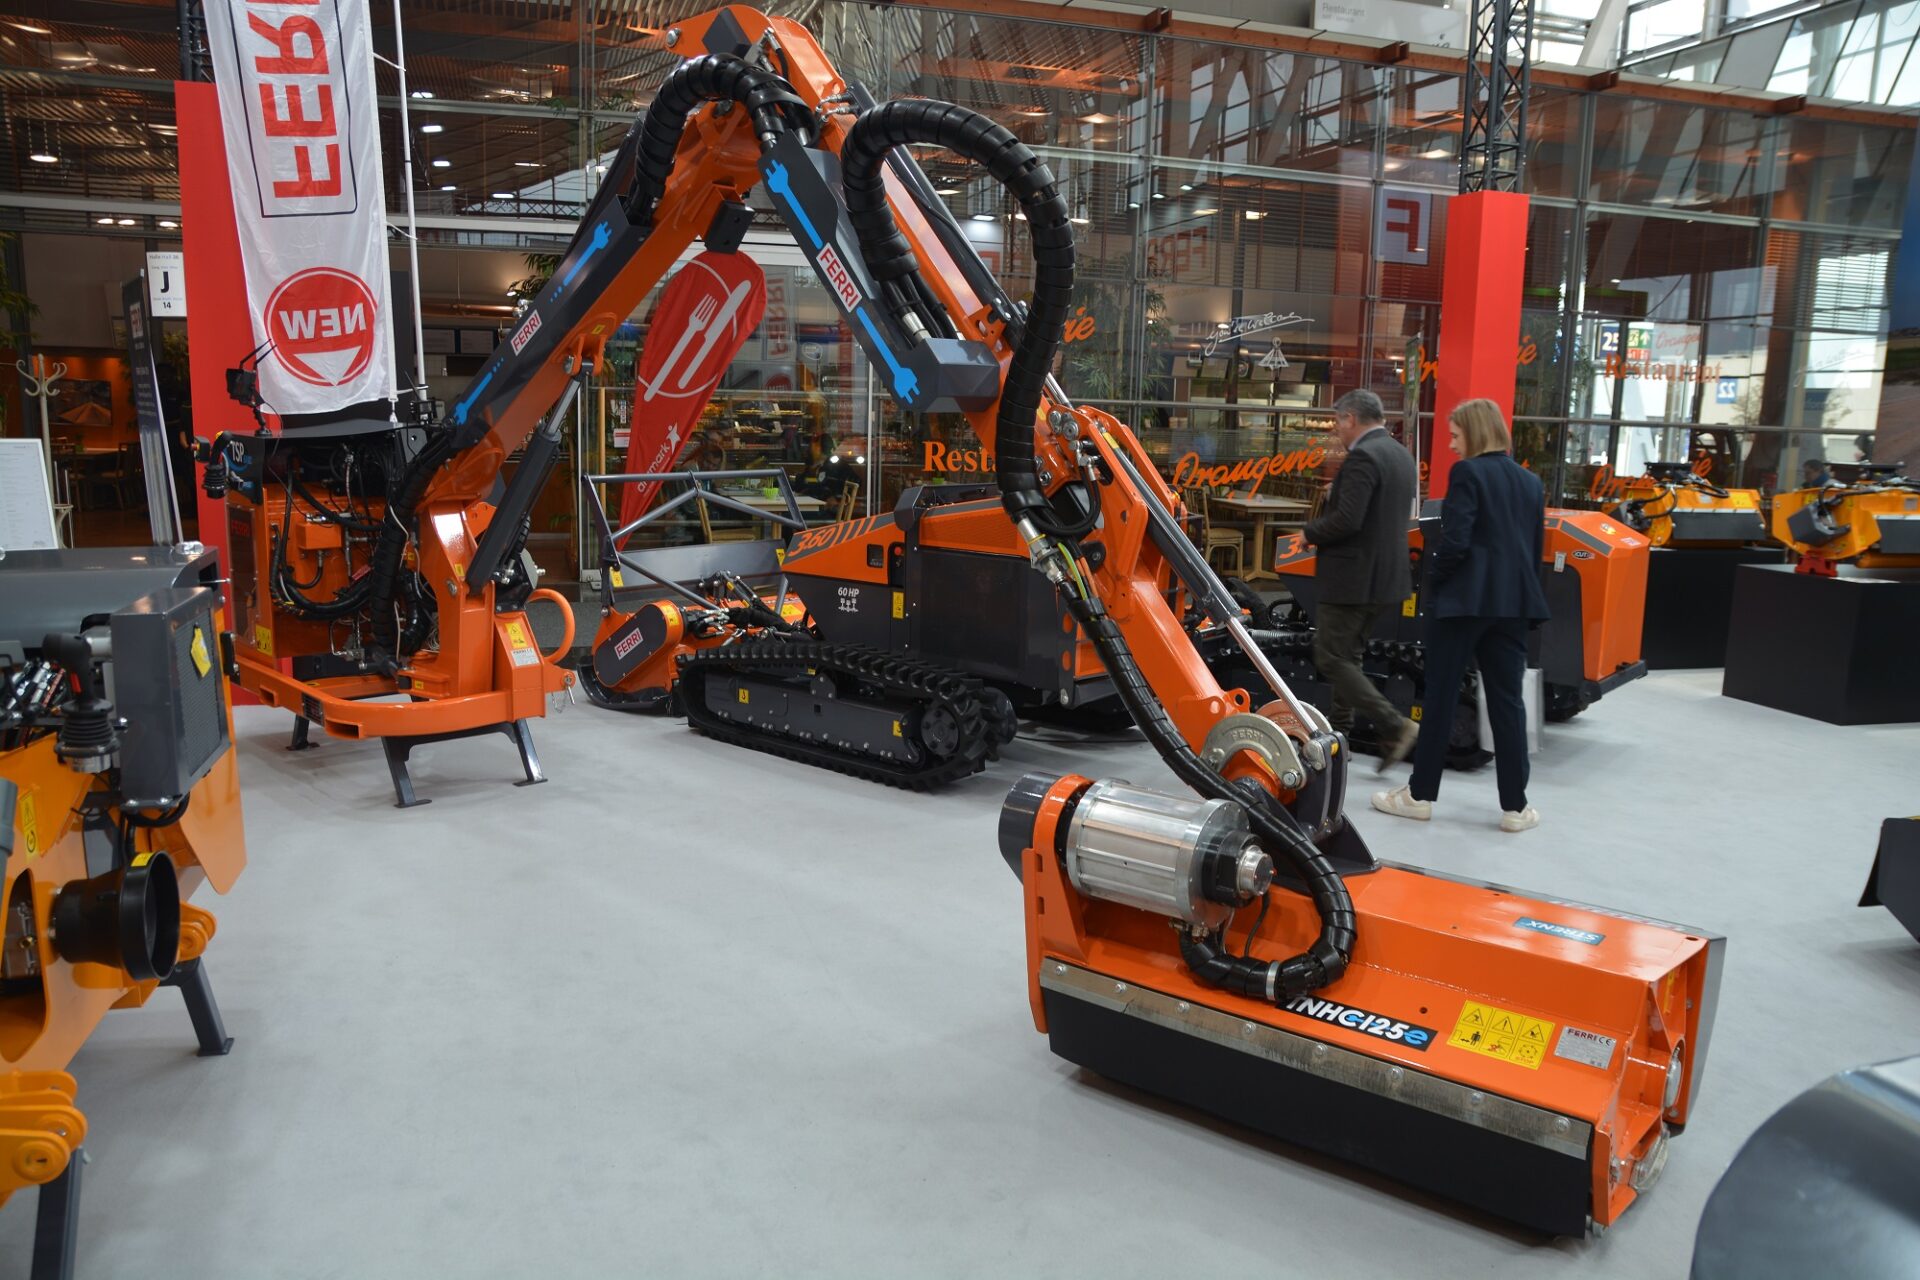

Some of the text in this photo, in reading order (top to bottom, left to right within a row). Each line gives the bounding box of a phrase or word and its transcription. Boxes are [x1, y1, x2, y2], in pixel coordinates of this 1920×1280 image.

[160, 271, 169, 293] J
[820, 248, 859, 307] FERRI
[512, 313, 540, 351] FERRI
[1604, 352, 1723, 384] Restaurant
[1172, 438, 1328, 500] Orangerie
[837, 586, 860, 598] 60 HP
[616, 630, 641, 657] FERRI
